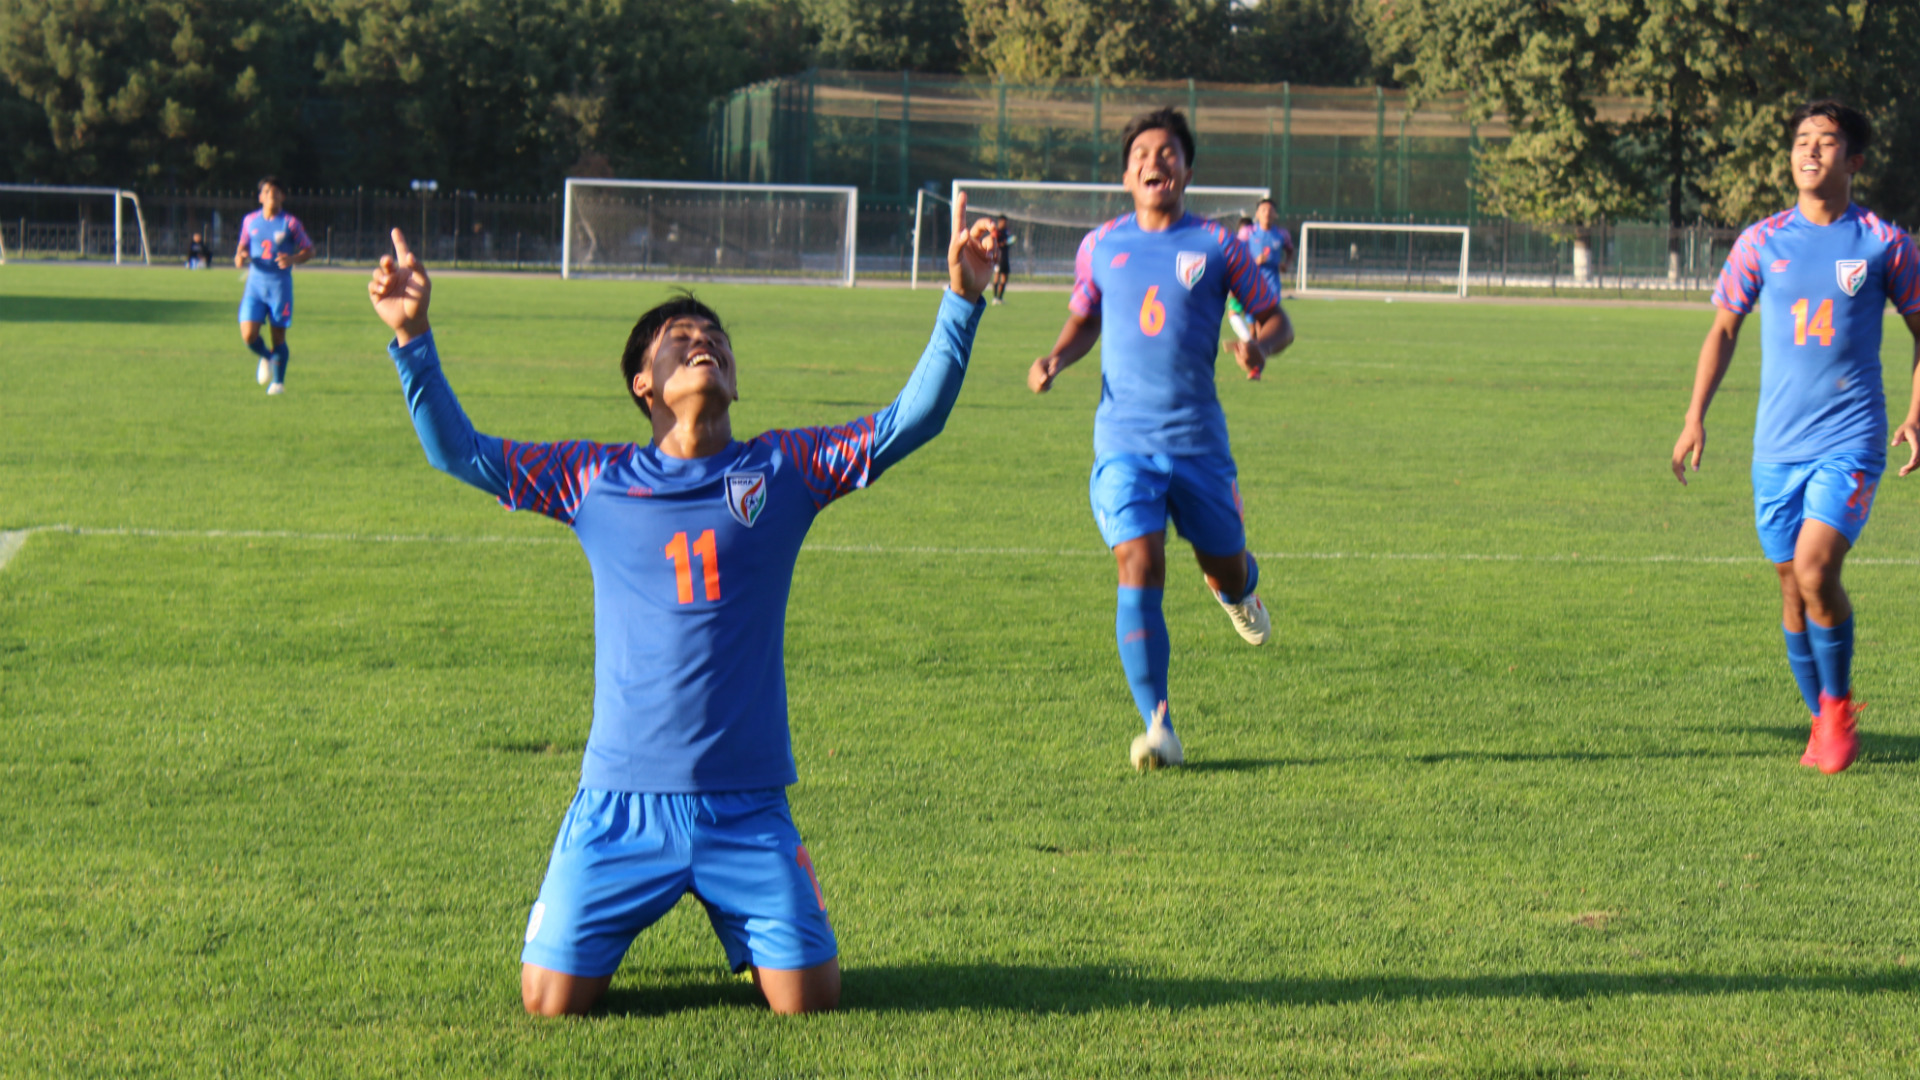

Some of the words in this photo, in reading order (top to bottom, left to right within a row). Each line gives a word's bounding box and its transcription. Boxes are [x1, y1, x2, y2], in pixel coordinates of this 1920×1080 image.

[261, 239, 273, 259] 2
[1139, 285, 1166, 337] 6
[1790, 298, 1836, 346] 14
[664, 529, 721, 604] 11
